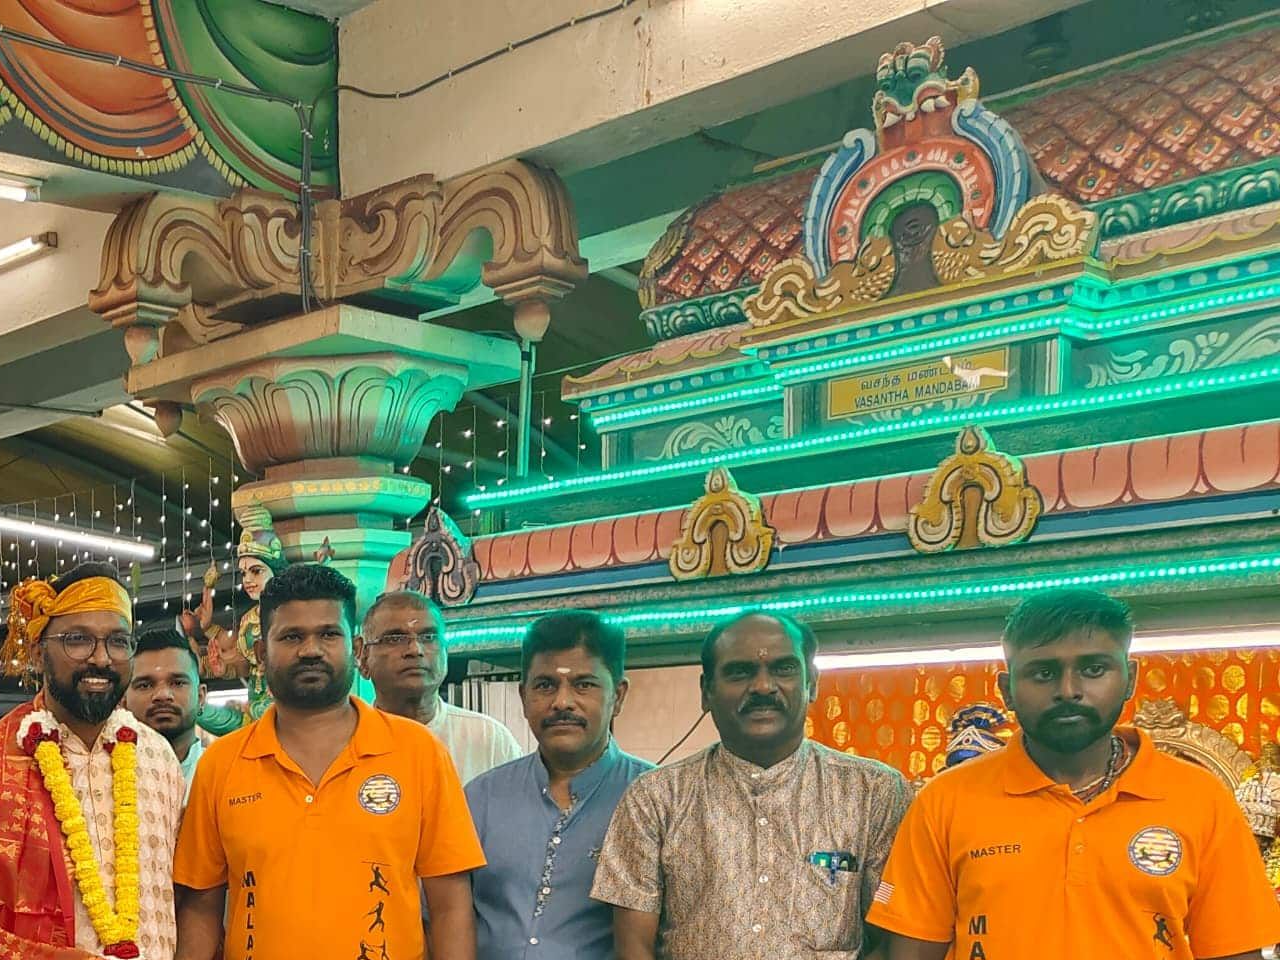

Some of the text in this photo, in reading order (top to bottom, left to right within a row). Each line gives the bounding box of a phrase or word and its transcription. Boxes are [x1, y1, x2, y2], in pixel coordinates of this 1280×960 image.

[907, 358, 972, 382] மண்டம்
[854, 388, 909, 408] VASANTHA
[228, 792, 263, 806] MASTER
[970, 844, 1022, 859] MASTER
